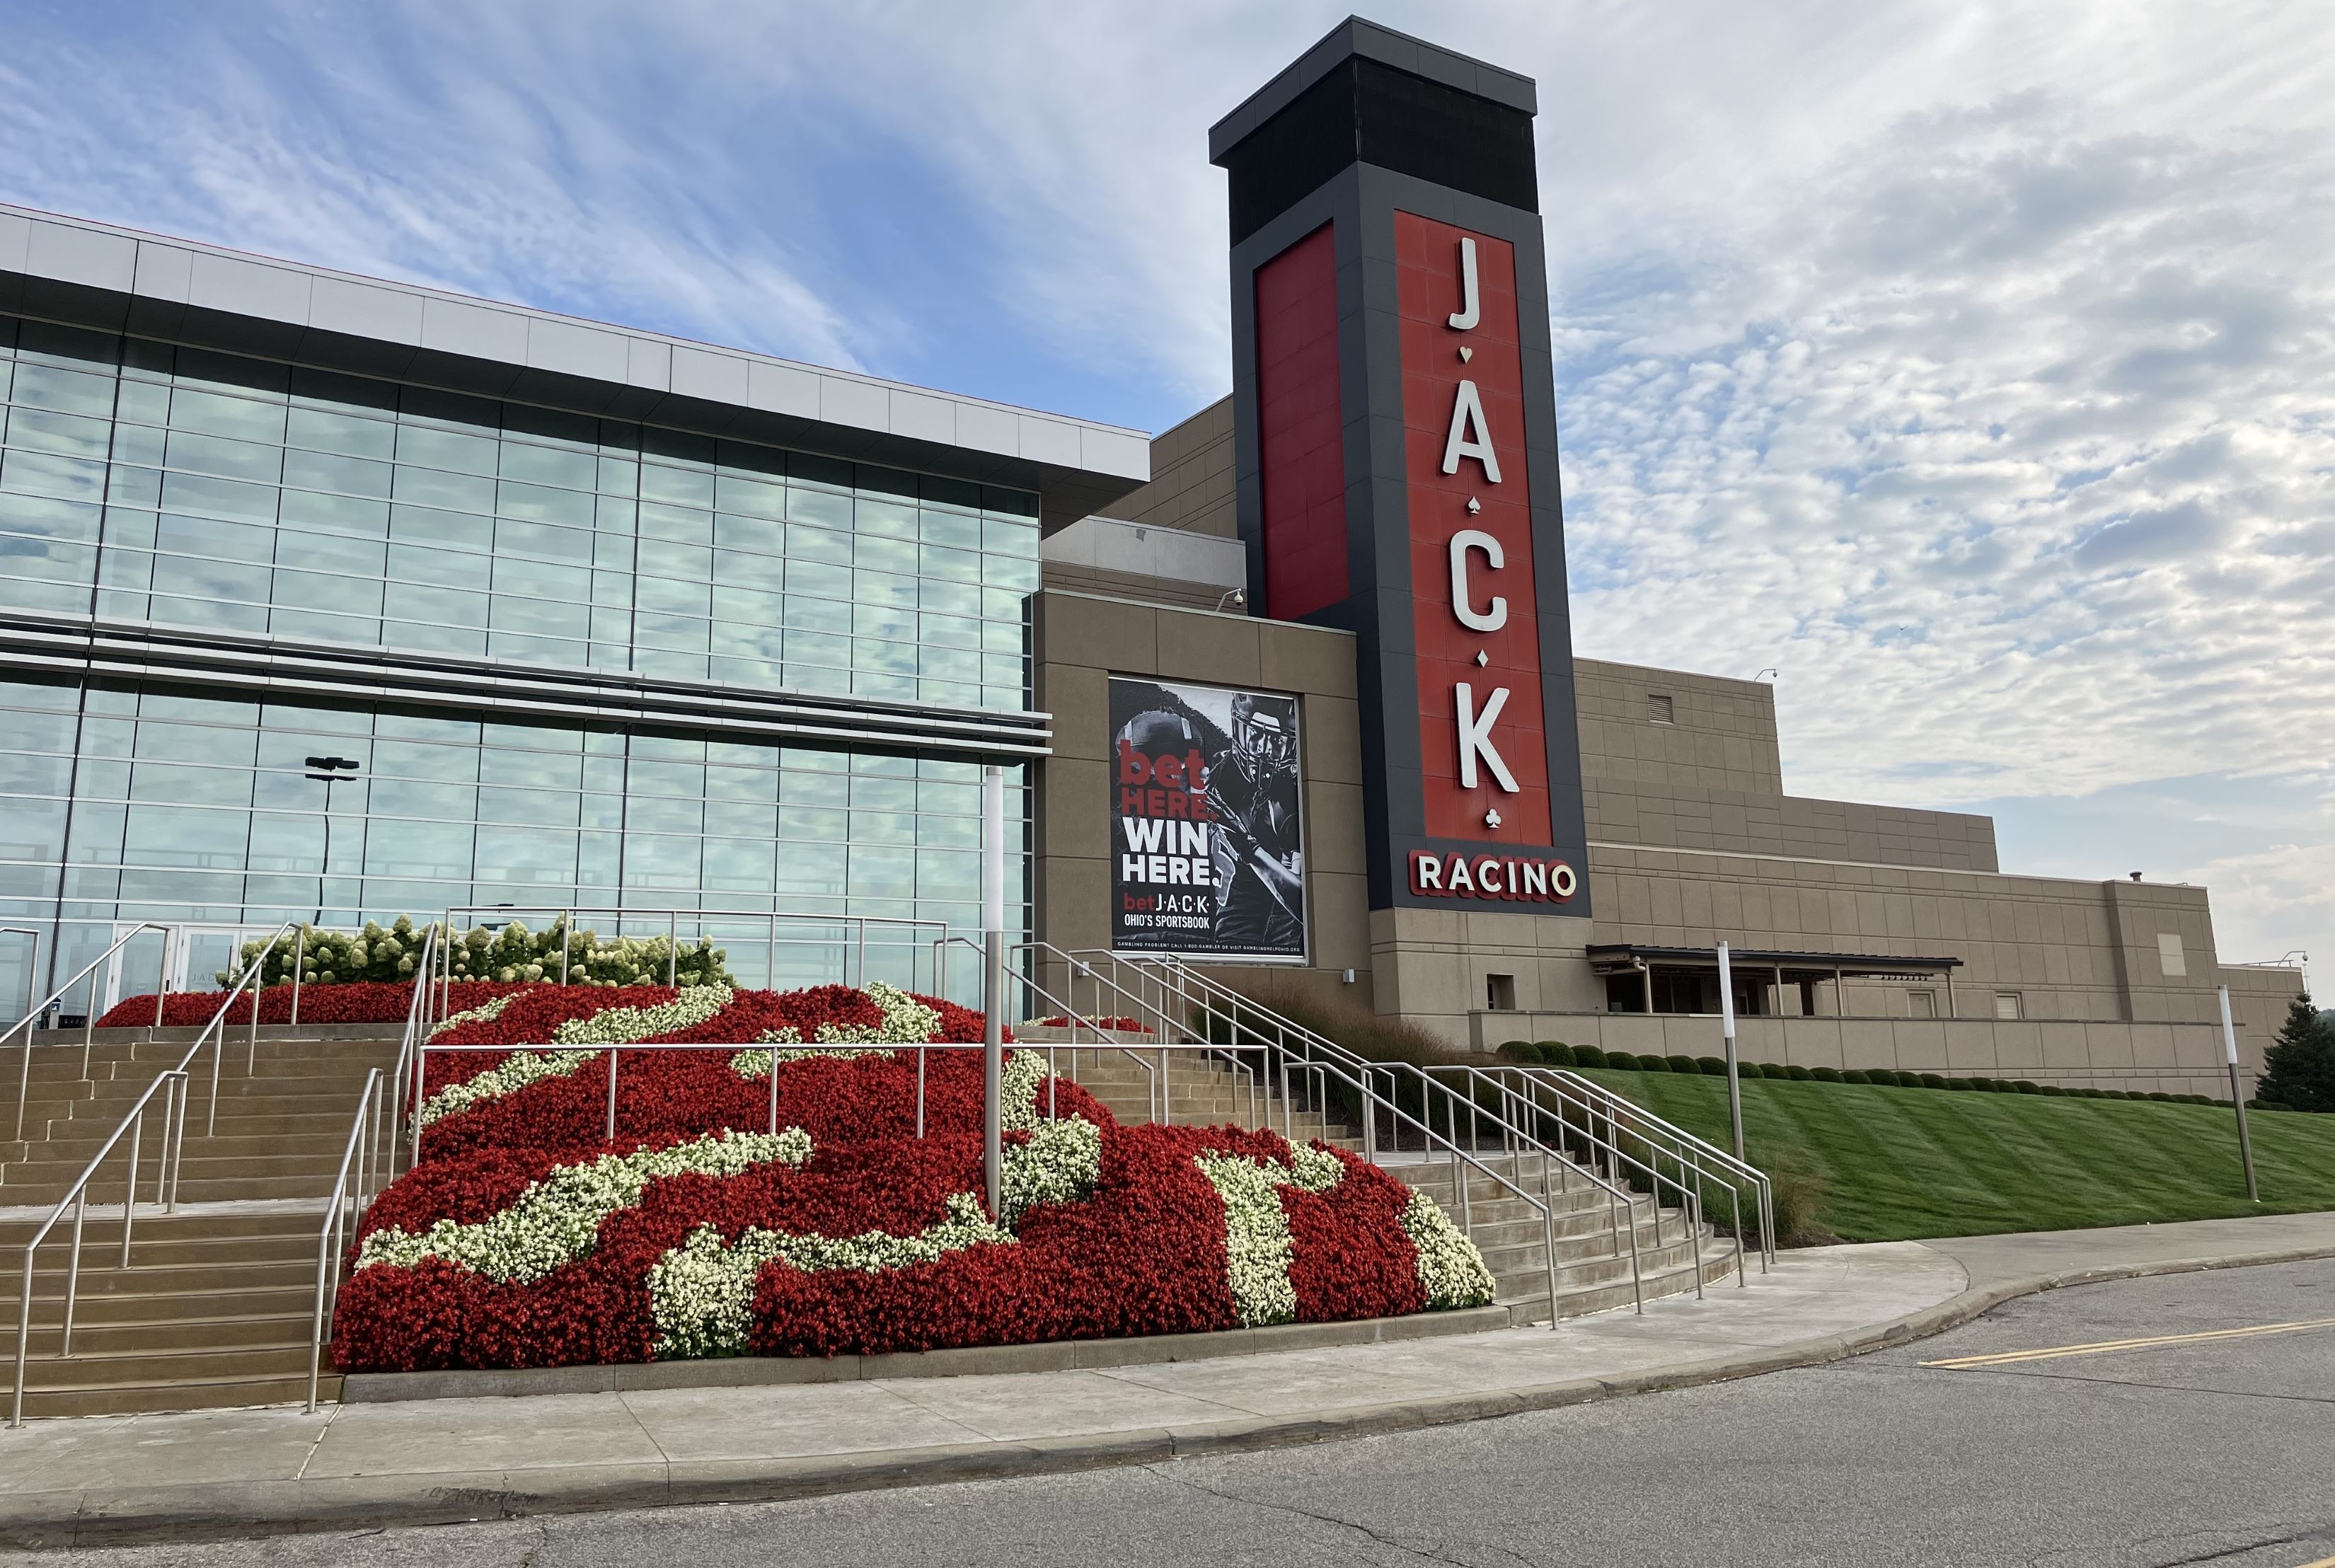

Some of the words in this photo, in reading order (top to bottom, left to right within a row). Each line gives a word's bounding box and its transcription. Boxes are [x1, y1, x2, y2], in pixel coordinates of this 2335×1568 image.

[1121, 739, 1206, 790] bet
[1122, 787, 1218, 821] HERE.
[1122, 817, 1208, 856] WIN
[1122, 853, 1220, 886] HERE.
[1419, 855, 1577, 897] RACINO
[1124, 913, 1153, 926] OHIO'S
[1155, 915, 1210, 929] SPORTSBOOK
